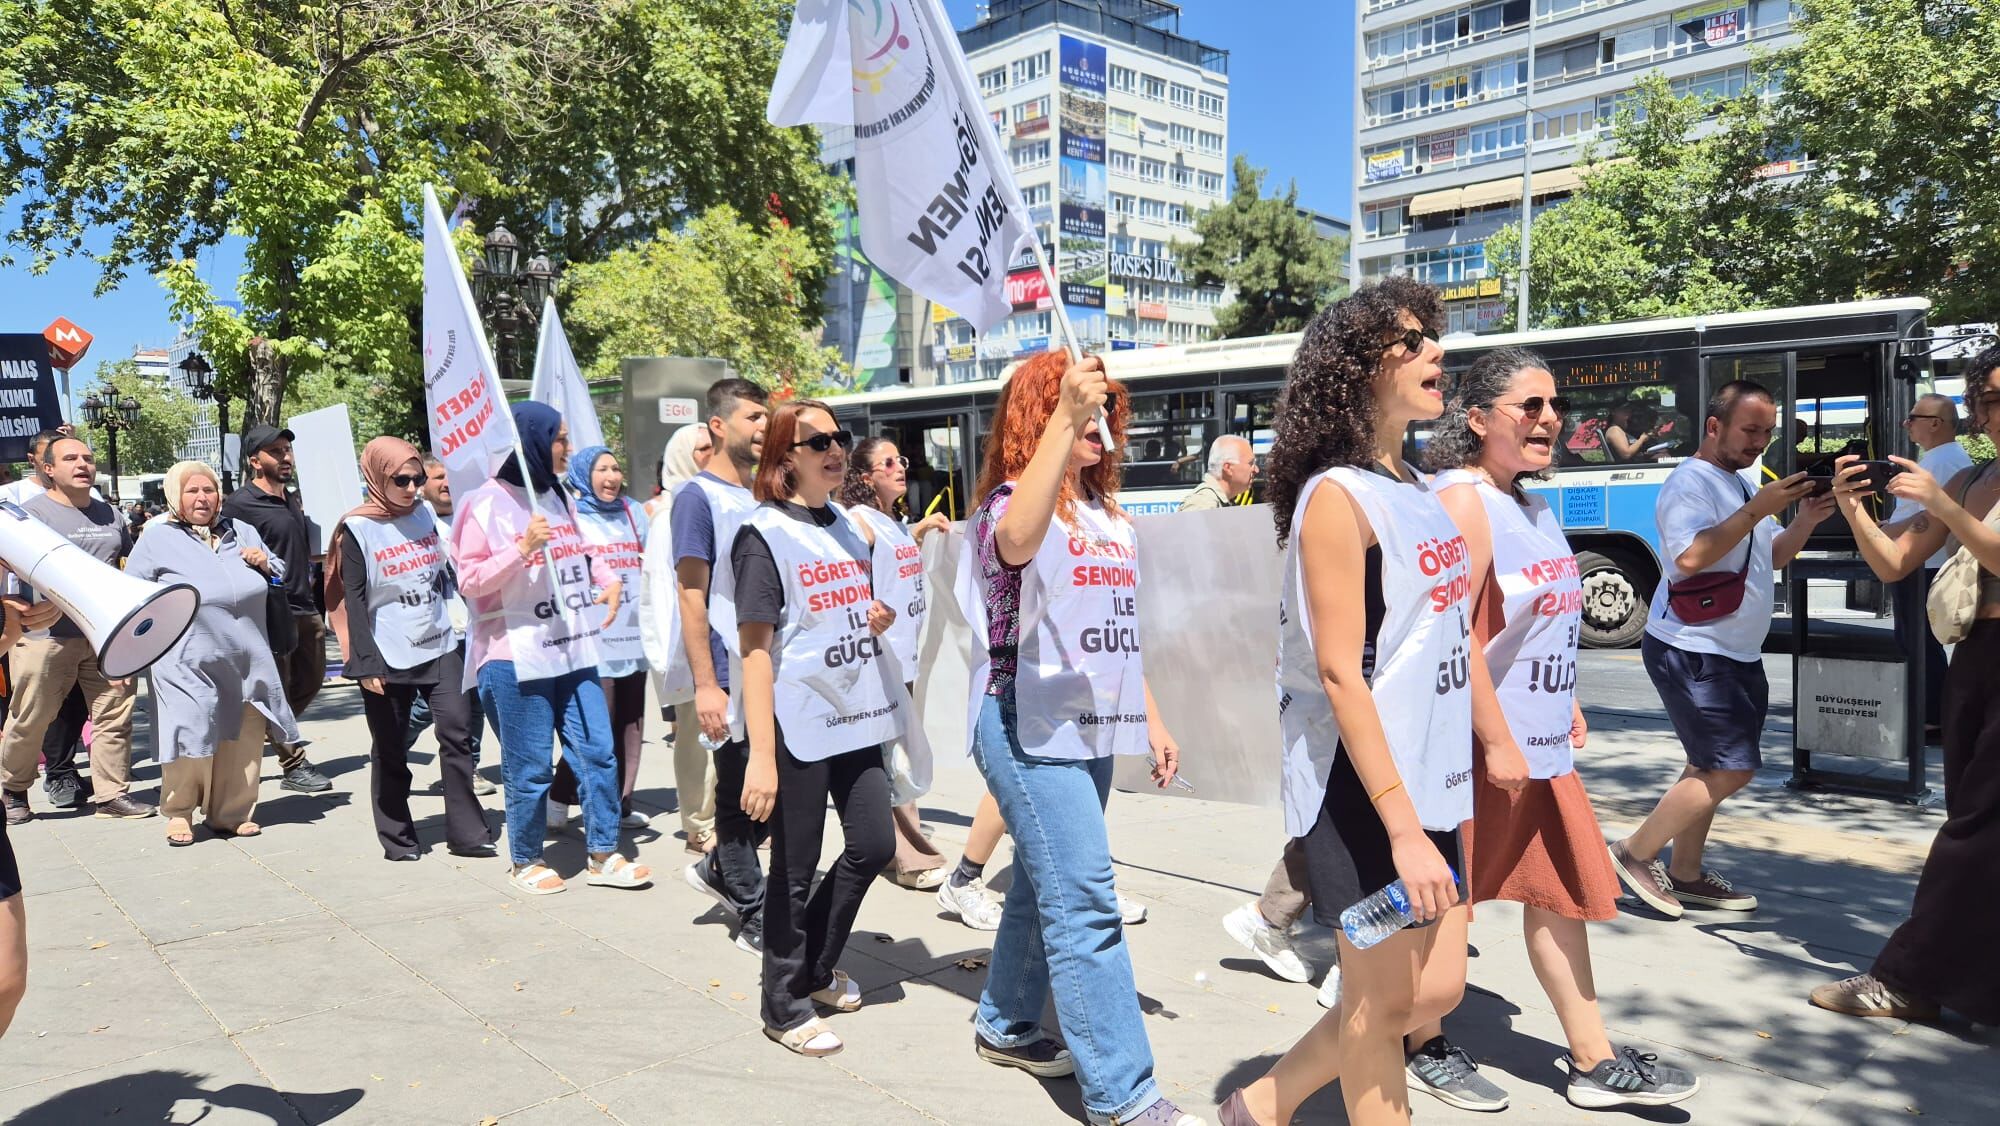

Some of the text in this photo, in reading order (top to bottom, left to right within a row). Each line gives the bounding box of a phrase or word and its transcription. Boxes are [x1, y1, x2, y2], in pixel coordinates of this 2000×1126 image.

[56, 327, 82, 342] M
[1, 360, 39, 381] MAAŞ
[1112, 590, 1134, 616] İLE
[826, 711, 872, 728] ÖĞRETMEN
